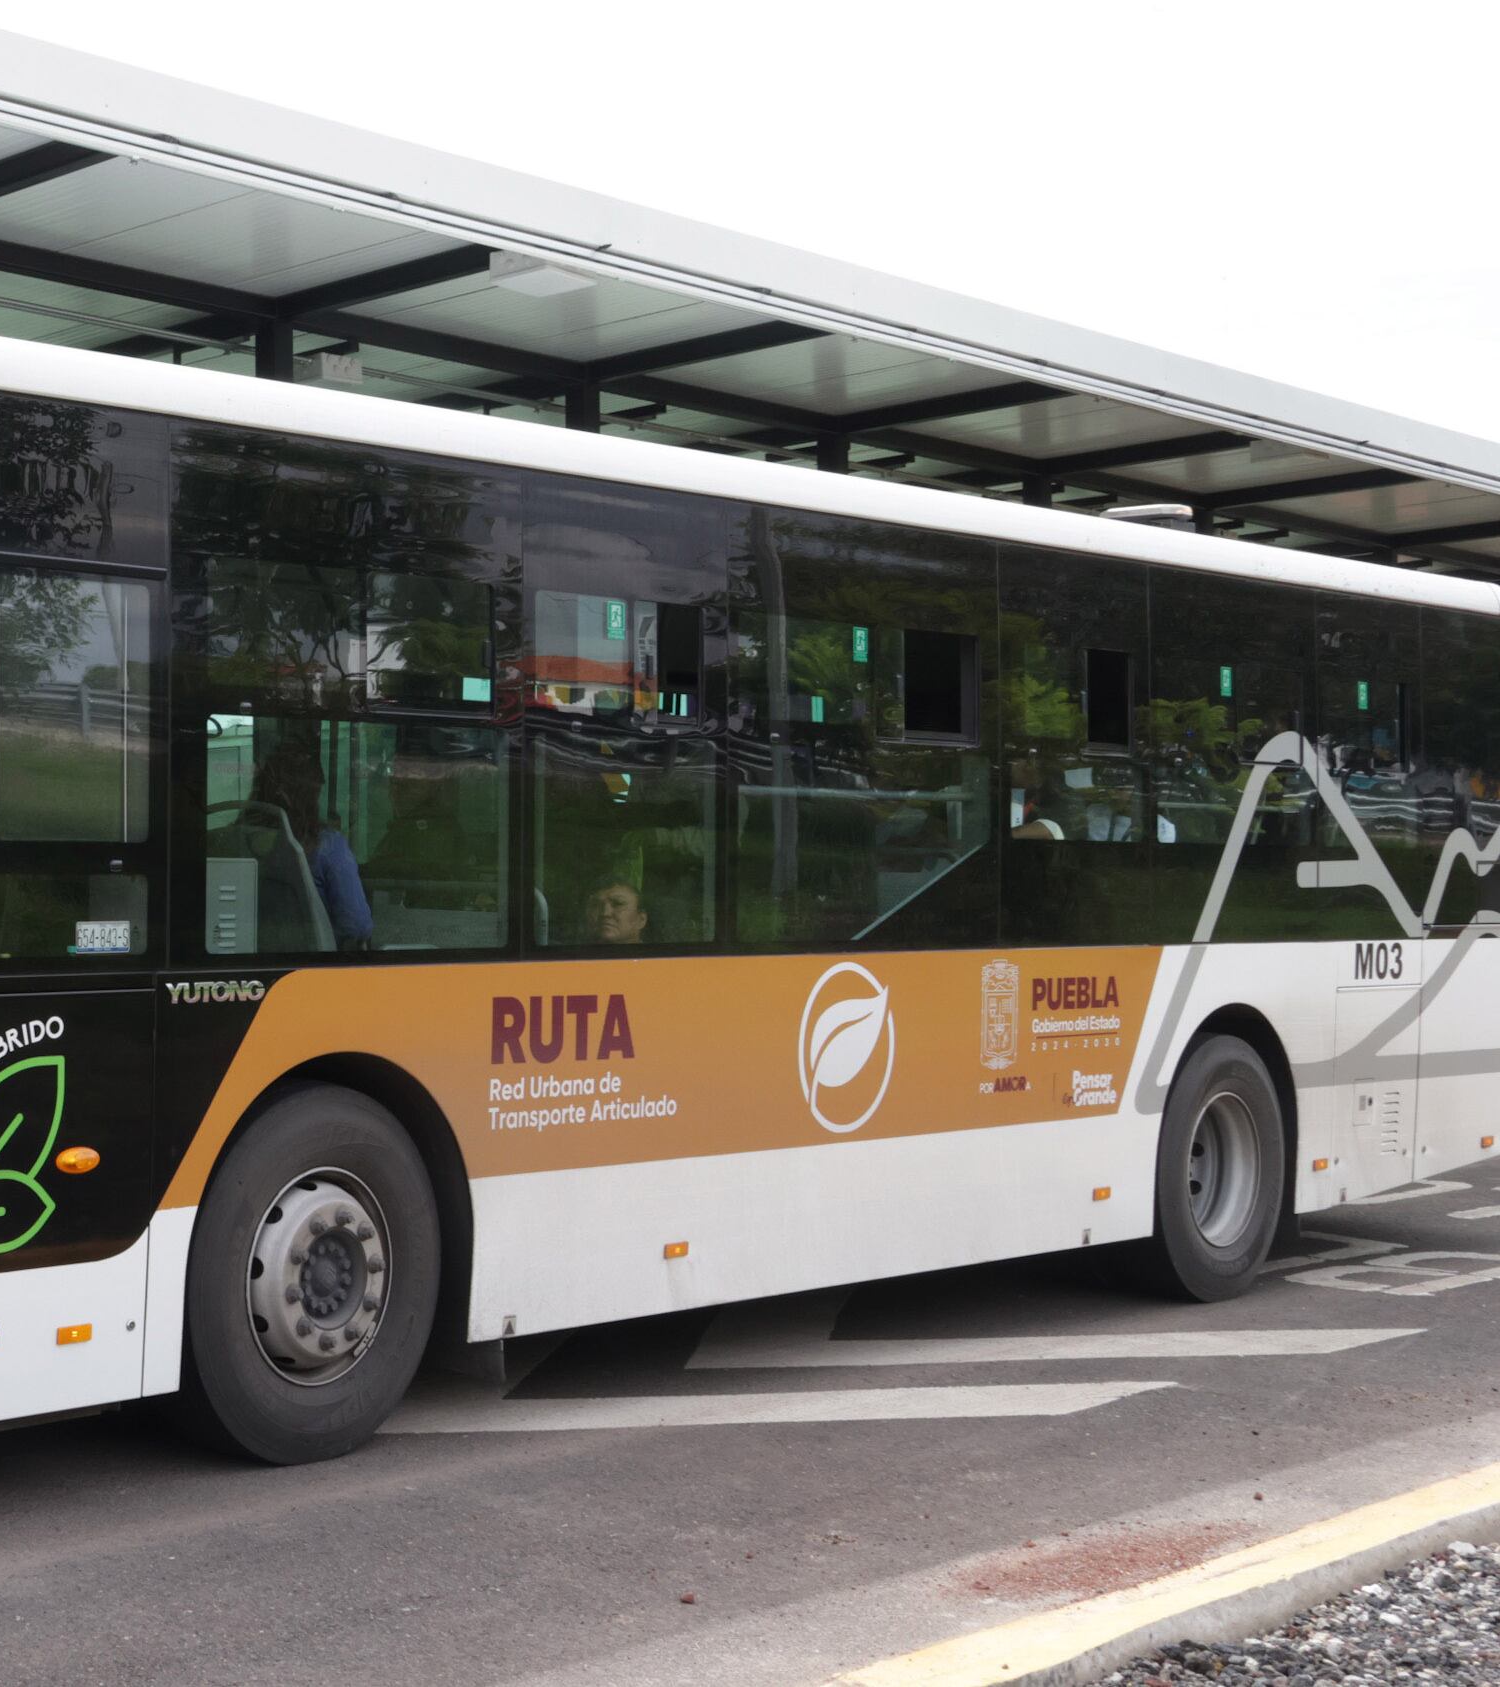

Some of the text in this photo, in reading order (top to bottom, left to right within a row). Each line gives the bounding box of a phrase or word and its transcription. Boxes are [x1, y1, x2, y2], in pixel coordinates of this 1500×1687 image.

[77, 928, 130, 948] 654-843-S
[1355, 942, 1403, 980] M03
[165, 980, 267, 1004] YUTONG
[1032, 976, 1119, 1011] PUEBLA
[491, 994, 635, 1065] RUTA
[1032, 1015, 1121, 1034] Gobierno del Estado
[489, 1071, 622, 1101] Red Urbana de
[1072, 1070, 1113, 1090] Pensar
[1073, 1087, 1117, 1107] Grande
[488, 1094, 677, 1132] Transporte Articulado
